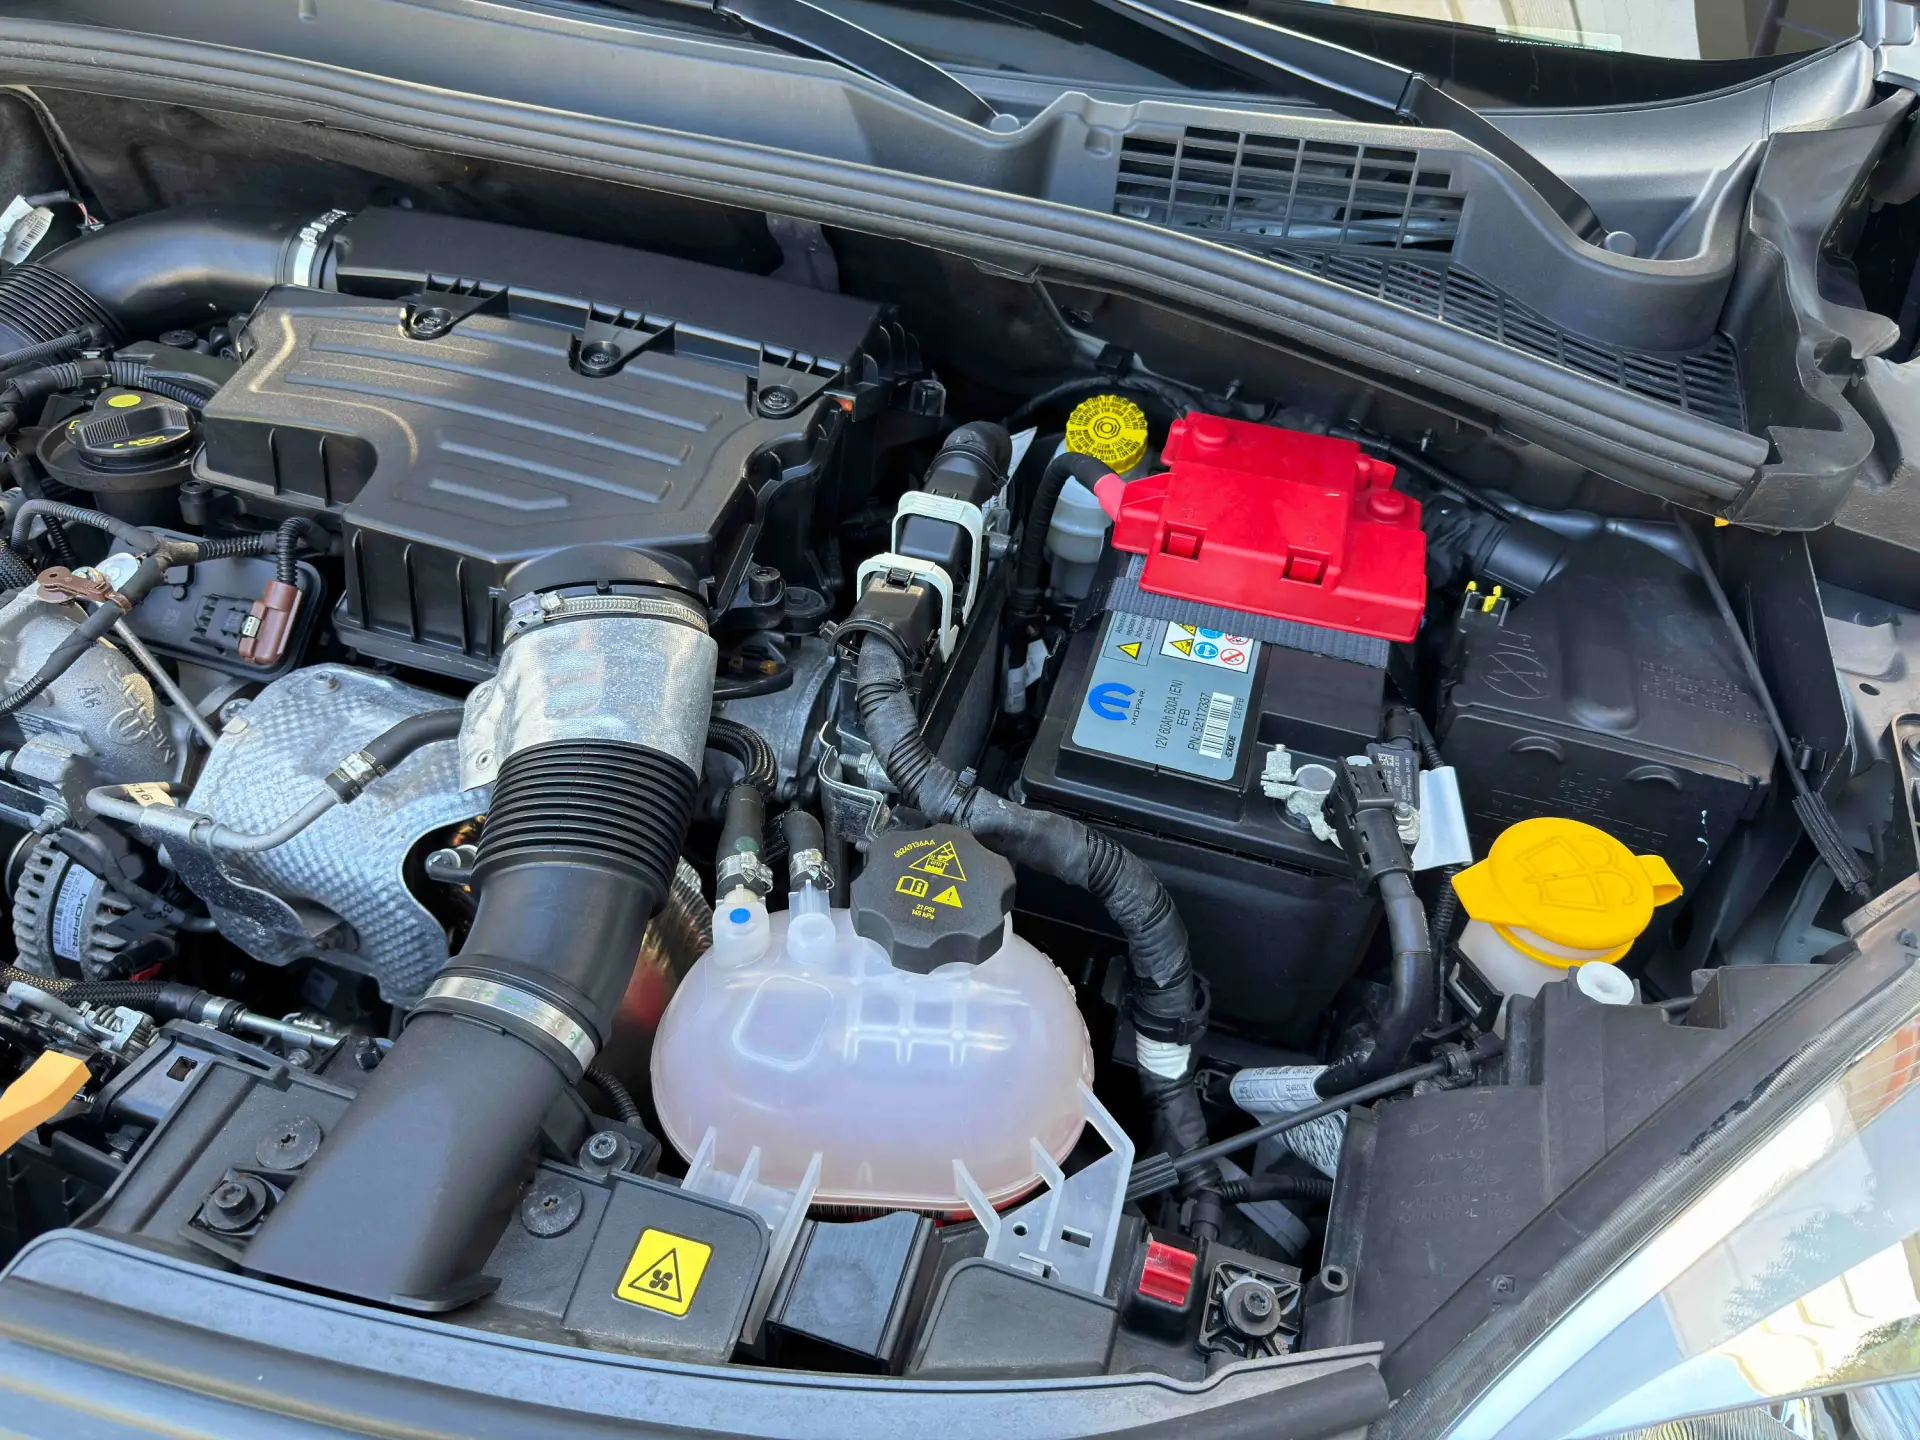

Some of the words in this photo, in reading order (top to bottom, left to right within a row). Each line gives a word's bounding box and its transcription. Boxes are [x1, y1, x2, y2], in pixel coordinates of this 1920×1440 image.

[1169, 679, 1186, 699] (EN)
[1164, 696, 1178, 716] 600A
[1192, 692, 1211, 733] 52117337
[1235, 698, 1244, 712] EFB
[1159, 715, 1174, 735] 60Ah
[1177, 708, 1190, 726] EFB
[1155, 732, 1168, 749] 12V
[1188, 734, 1202, 751] PN:
[922, 912, 935, 920] kPa
[924, 905, 935, 913] PSI
